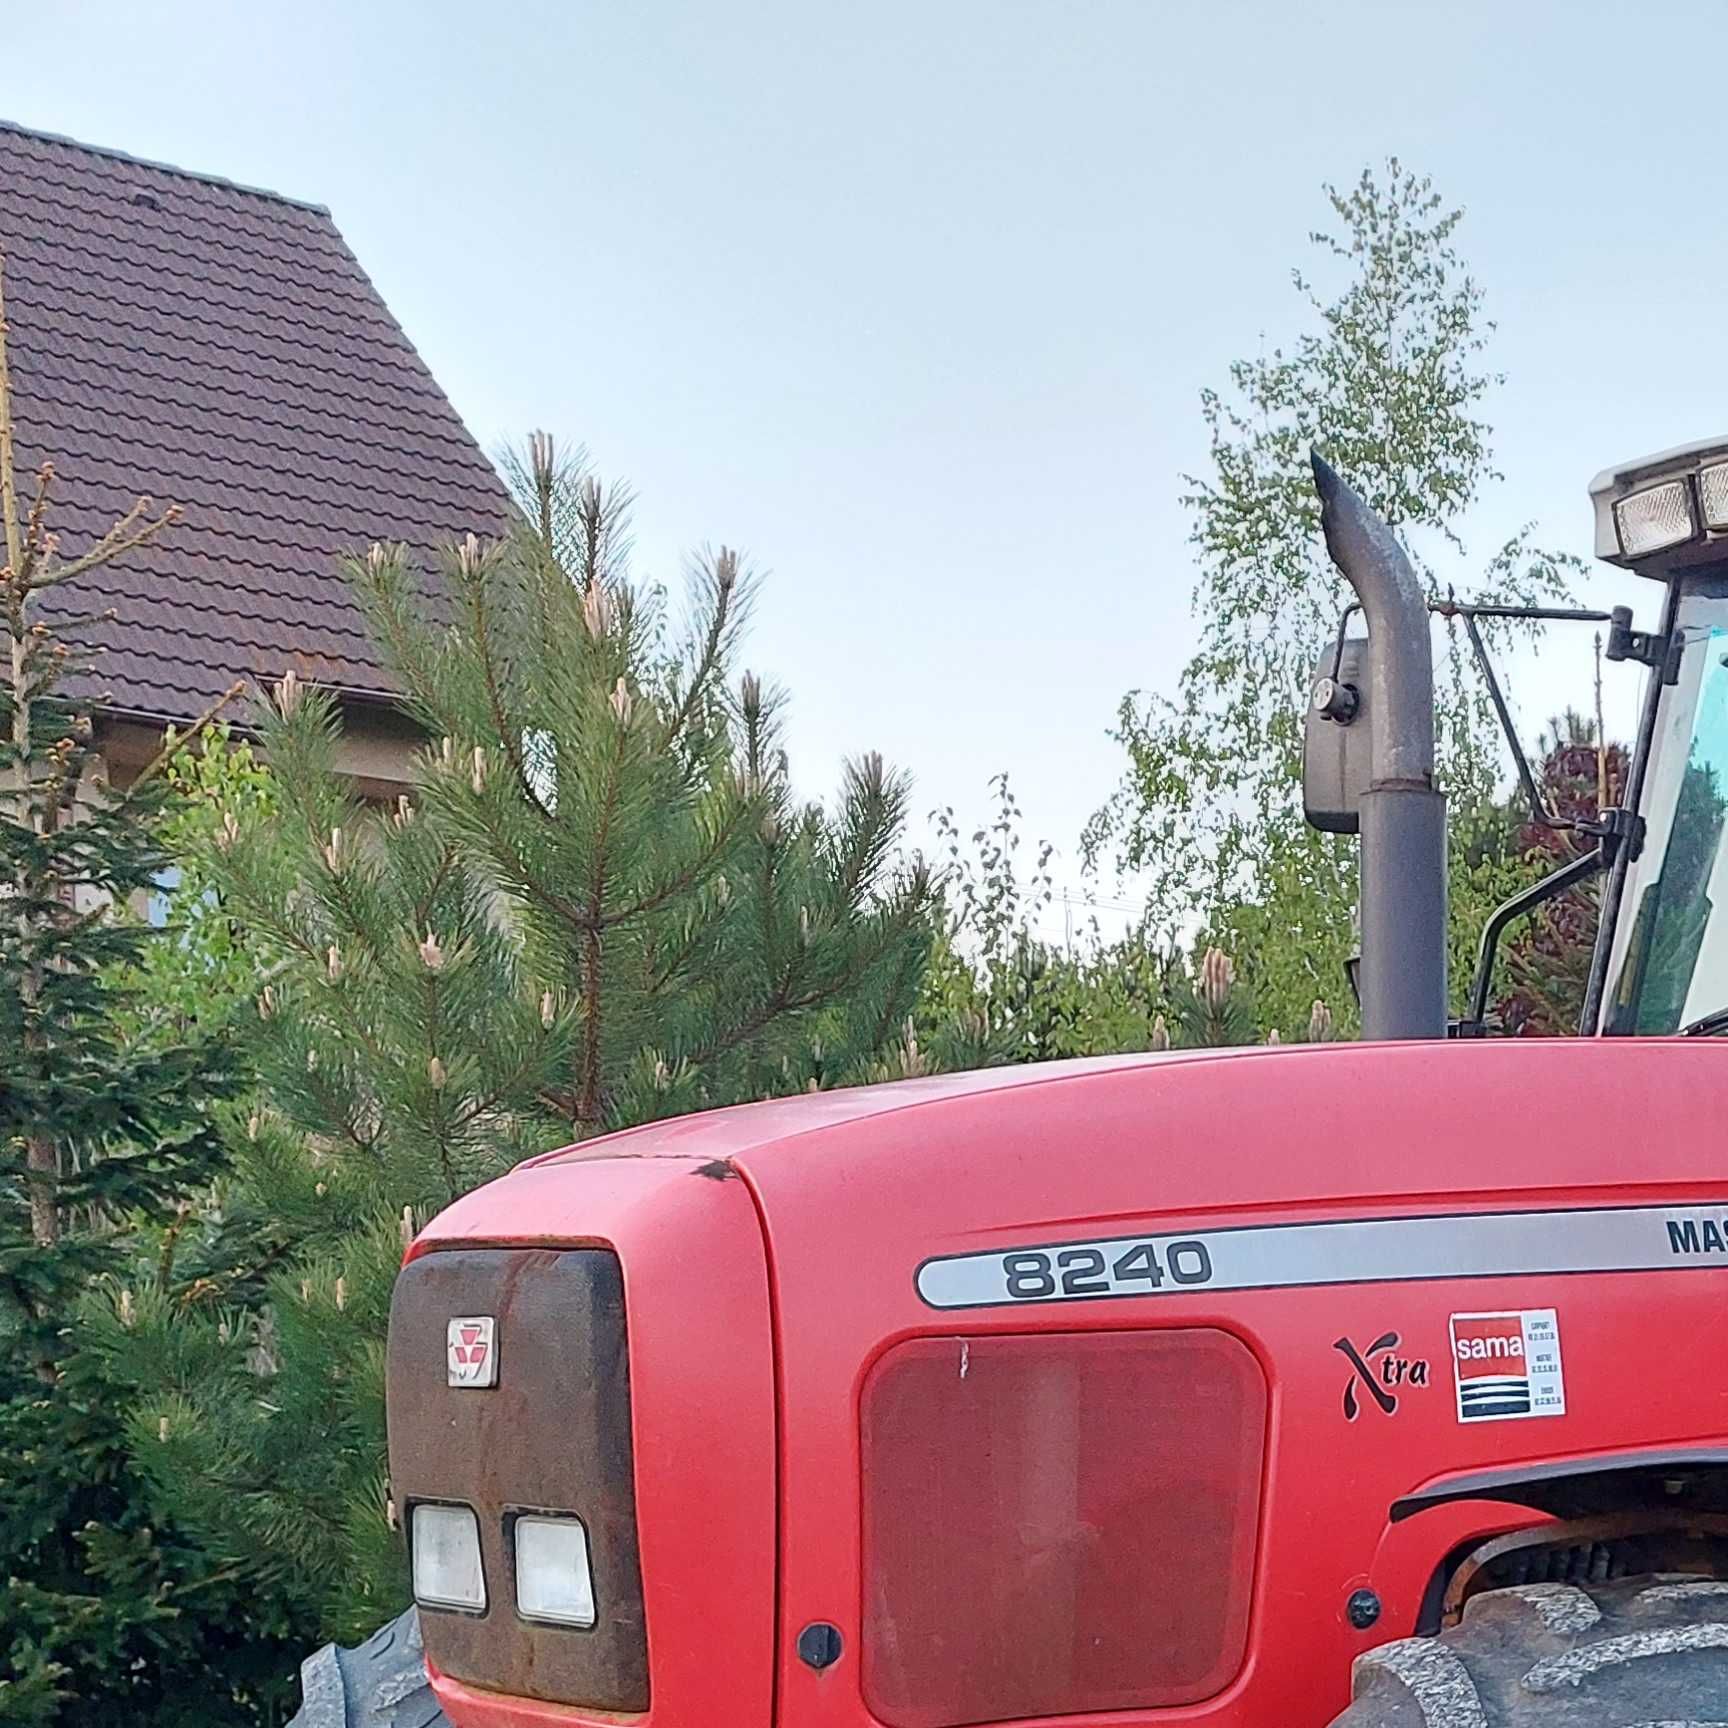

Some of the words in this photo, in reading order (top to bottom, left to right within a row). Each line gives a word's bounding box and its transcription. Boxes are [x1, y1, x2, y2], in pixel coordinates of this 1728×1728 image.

[1002, 1240, 1213, 1298] 8240
[1333, 1331, 1429, 1420] Xtra
[1457, 1334, 1524, 1361] sama
